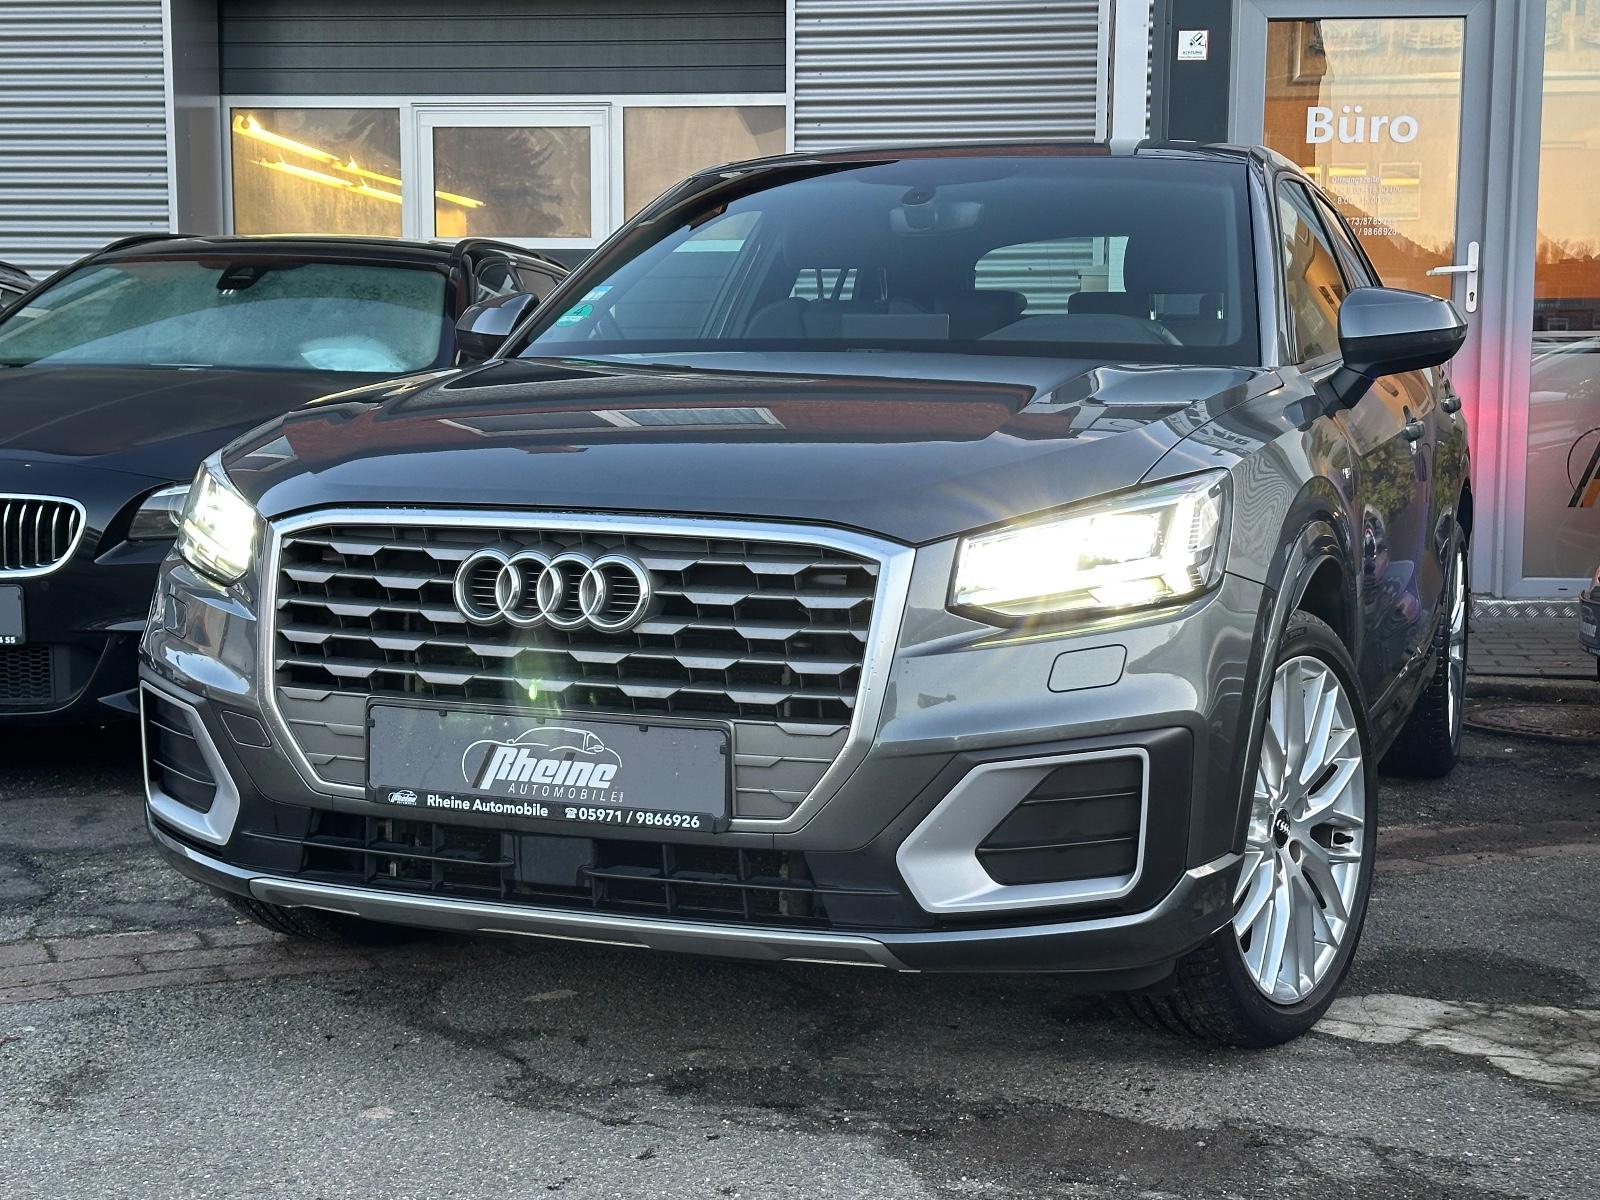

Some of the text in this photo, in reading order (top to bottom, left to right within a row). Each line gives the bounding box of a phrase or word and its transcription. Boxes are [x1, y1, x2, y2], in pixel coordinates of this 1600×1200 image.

[1306, 105, 1419, 144] Büro
[475, 744, 618, 790] Rheine
[507, 782, 618, 803] AUTOMOBILE
[427, 794, 700, 828] Rheine Automobile 05971 / 9866926
